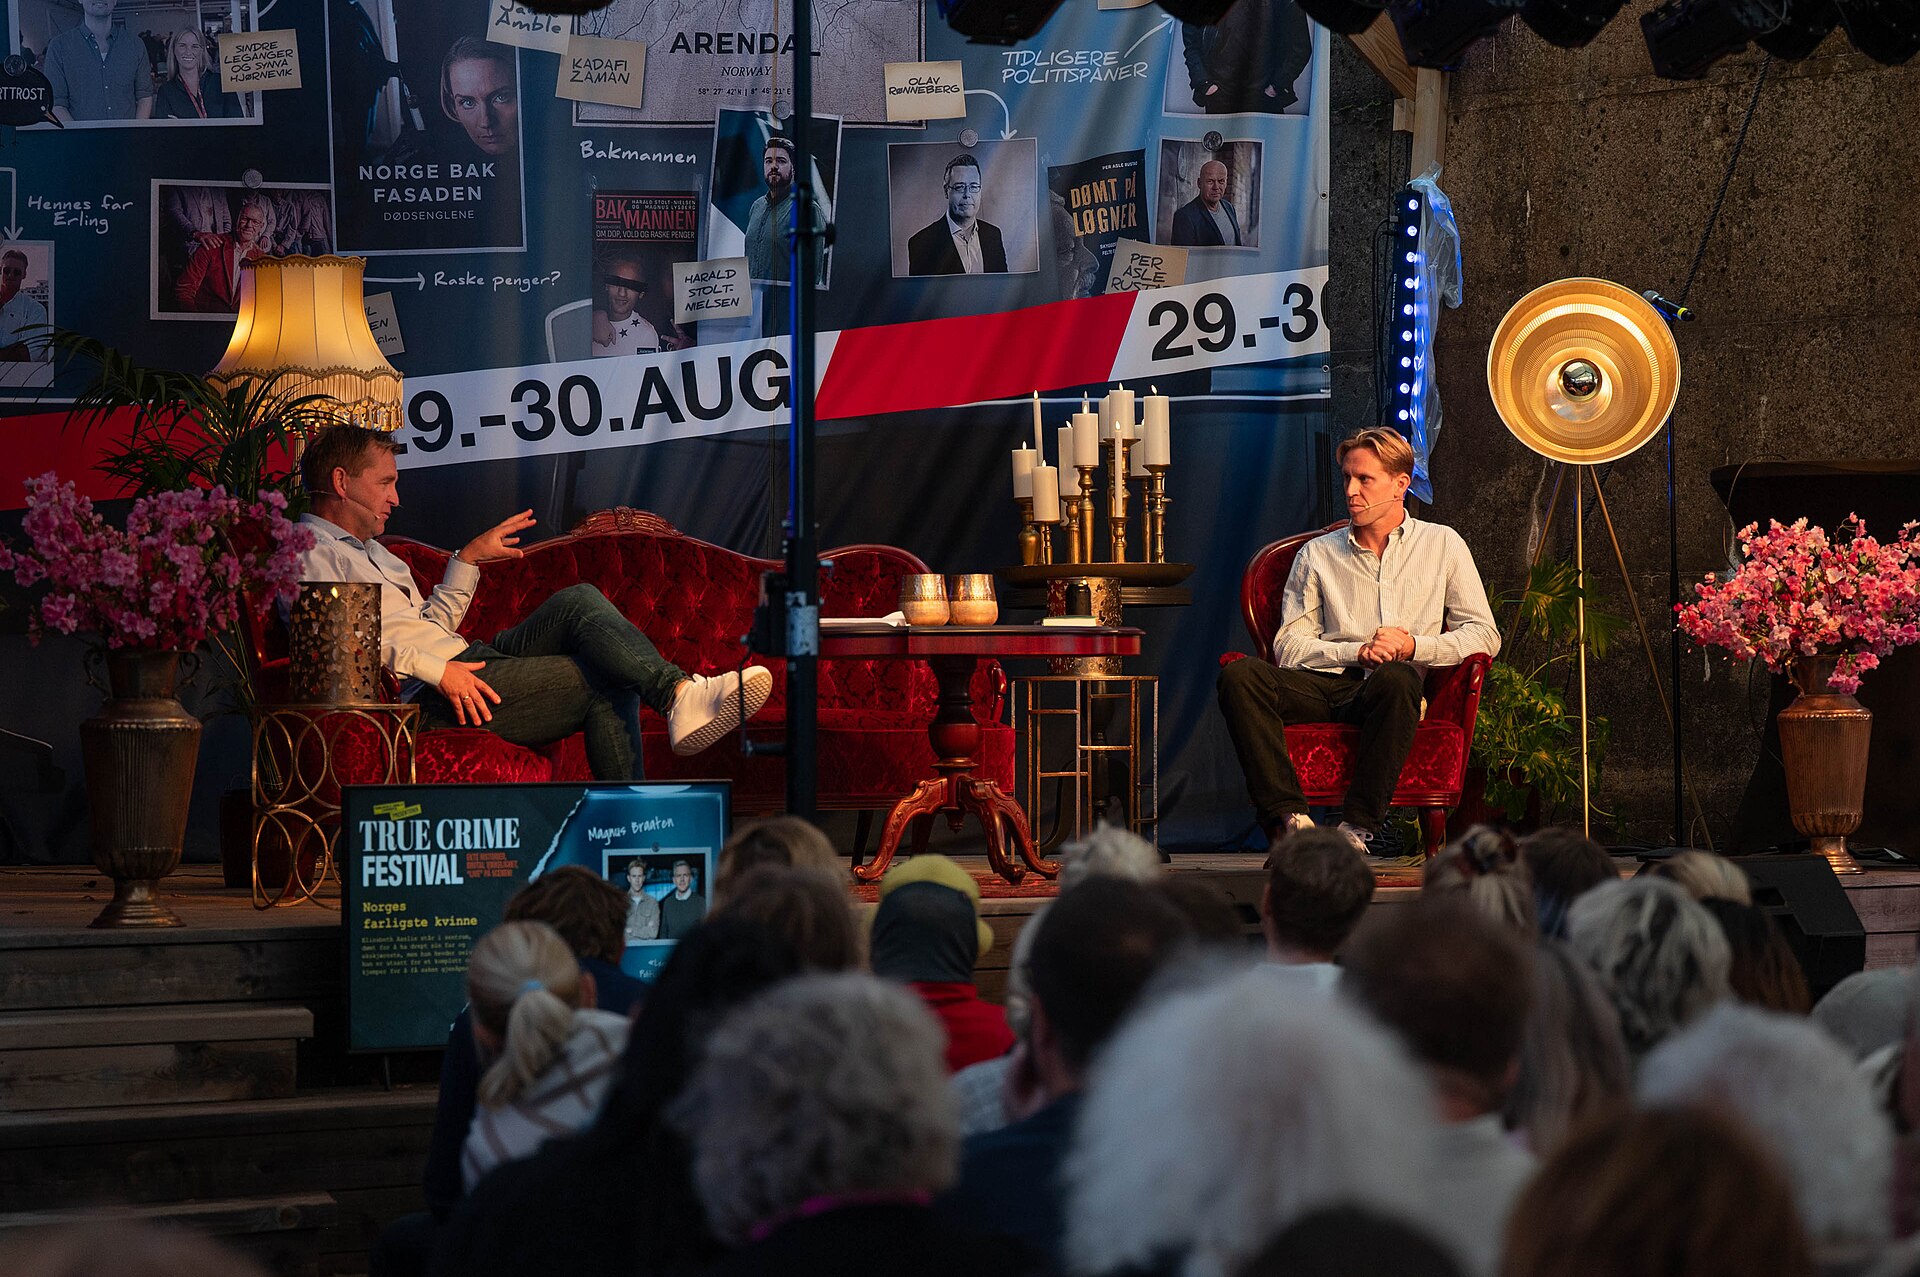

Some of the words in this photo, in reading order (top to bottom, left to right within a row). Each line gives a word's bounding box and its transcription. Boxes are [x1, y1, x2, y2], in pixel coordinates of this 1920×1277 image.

[495, 11, 561, 34] Amble
[235, 41, 278, 53] SINDRE
[224, 49, 293, 64] LEGANGER
[572, 58, 627, 71] KADAFI
[1001, 49, 1120, 67] TIDLIGERE
[230, 69, 293, 82] HJØRNEVIK
[231, 63, 251, 73] OG
[721, 66, 773, 76] NORWAY
[1001, 61, 1148, 84] POLITISPANER
[570, 70, 630, 84] ZAMAN
[908, 76, 940, 86] OLAV
[888, 84, 960, 95] RØNNEBERG
[580, 140, 697, 164] Bakmannen
[359, 164, 439, 180] NORGE
[449, 162, 497, 179] BAK
[373, 186, 482, 203] FASADEN
[1070, 177, 1118, 209] DØMT
[1124, 170, 1136, 200] PÅ
[27, 195, 92, 210] Hennes
[101, 194, 134, 210] far
[53, 210, 109, 235] Erling
[383, 210, 475, 221] DØDSENGLENE
[595, 199, 628, 220] BAK
[623, 209, 696, 230] MANNEN
[1072, 202, 1137, 237] LØGNER
[1130, 253, 1164, 271] PER
[434, 271, 485, 286] Raske
[492, 271, 561, 293] penger?
[685, 269, 737, 284] HARALD
[1122, 265, 1172, 283] ASLE
[685, 297, 740, 311] NIELSEN
[1148, 283, 1330, 361] 29.-3
[358, 819, 431, 852] TRUE
[436, 817, 521, 850] CRIME
[587, 826, 627, 846] Magnus
[631, 815, 675, 834] Braaten
[362, 853, 465, 888] FESTIVAL
[362, 901, 408, 915] Norges
[362, 917, 428, 931] farligste
[433, 915, 479, 928] kvinne
